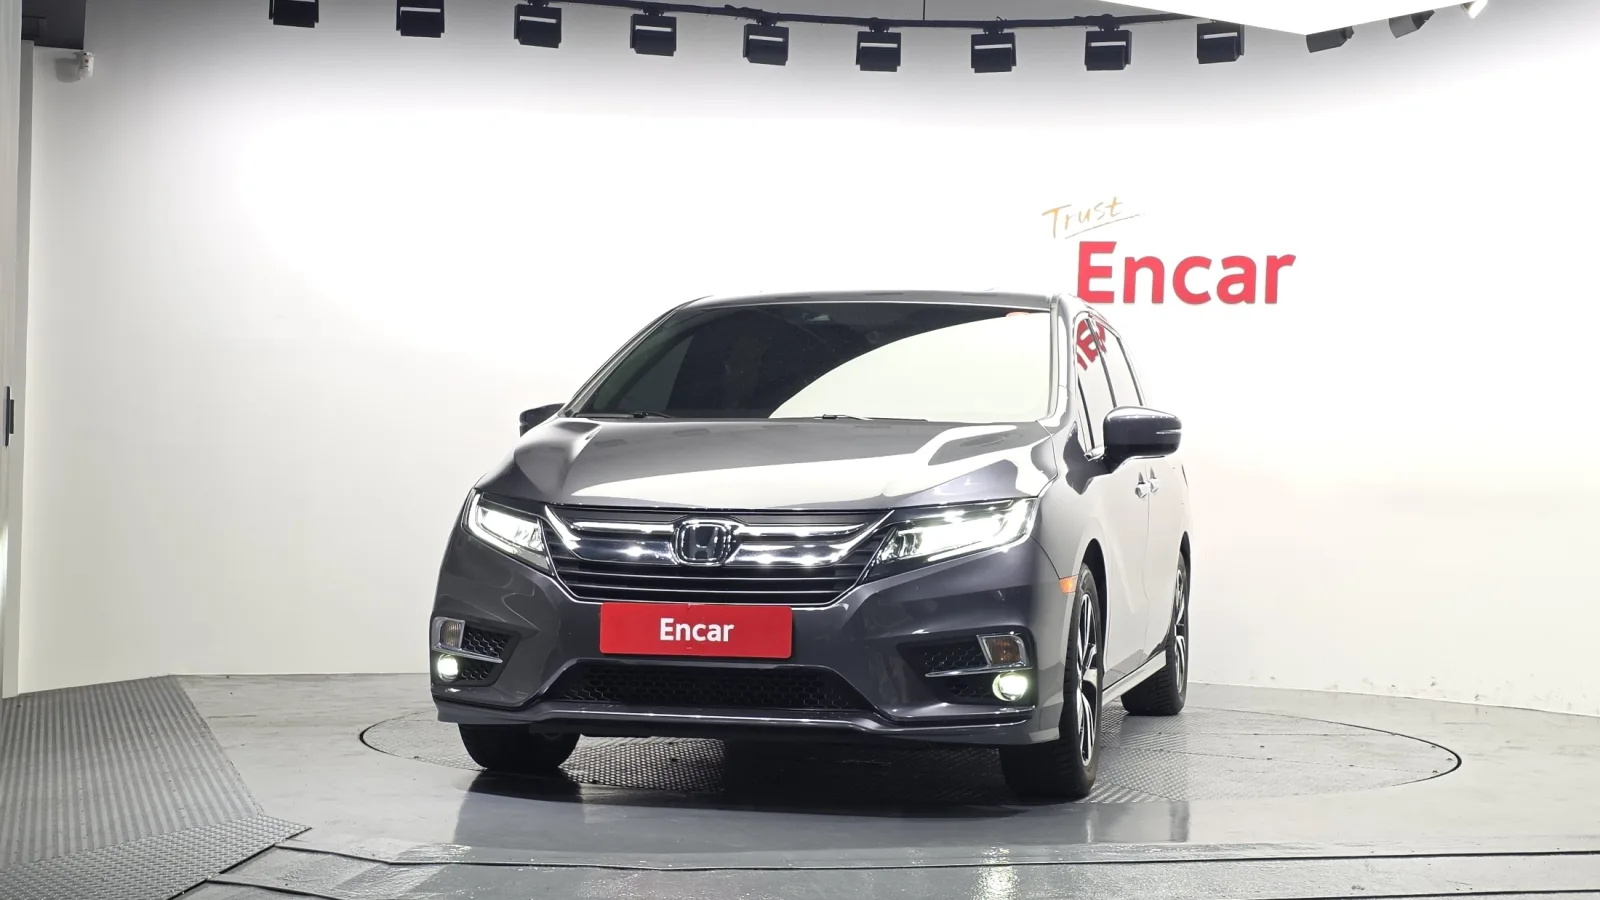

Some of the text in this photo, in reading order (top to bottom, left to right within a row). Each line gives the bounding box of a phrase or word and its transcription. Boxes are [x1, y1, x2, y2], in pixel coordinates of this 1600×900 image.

[1041, 196, 1123, 239] Trust
[1077, 241, 1296, 305] Encar
[660, 617, 735, 642] Encar
